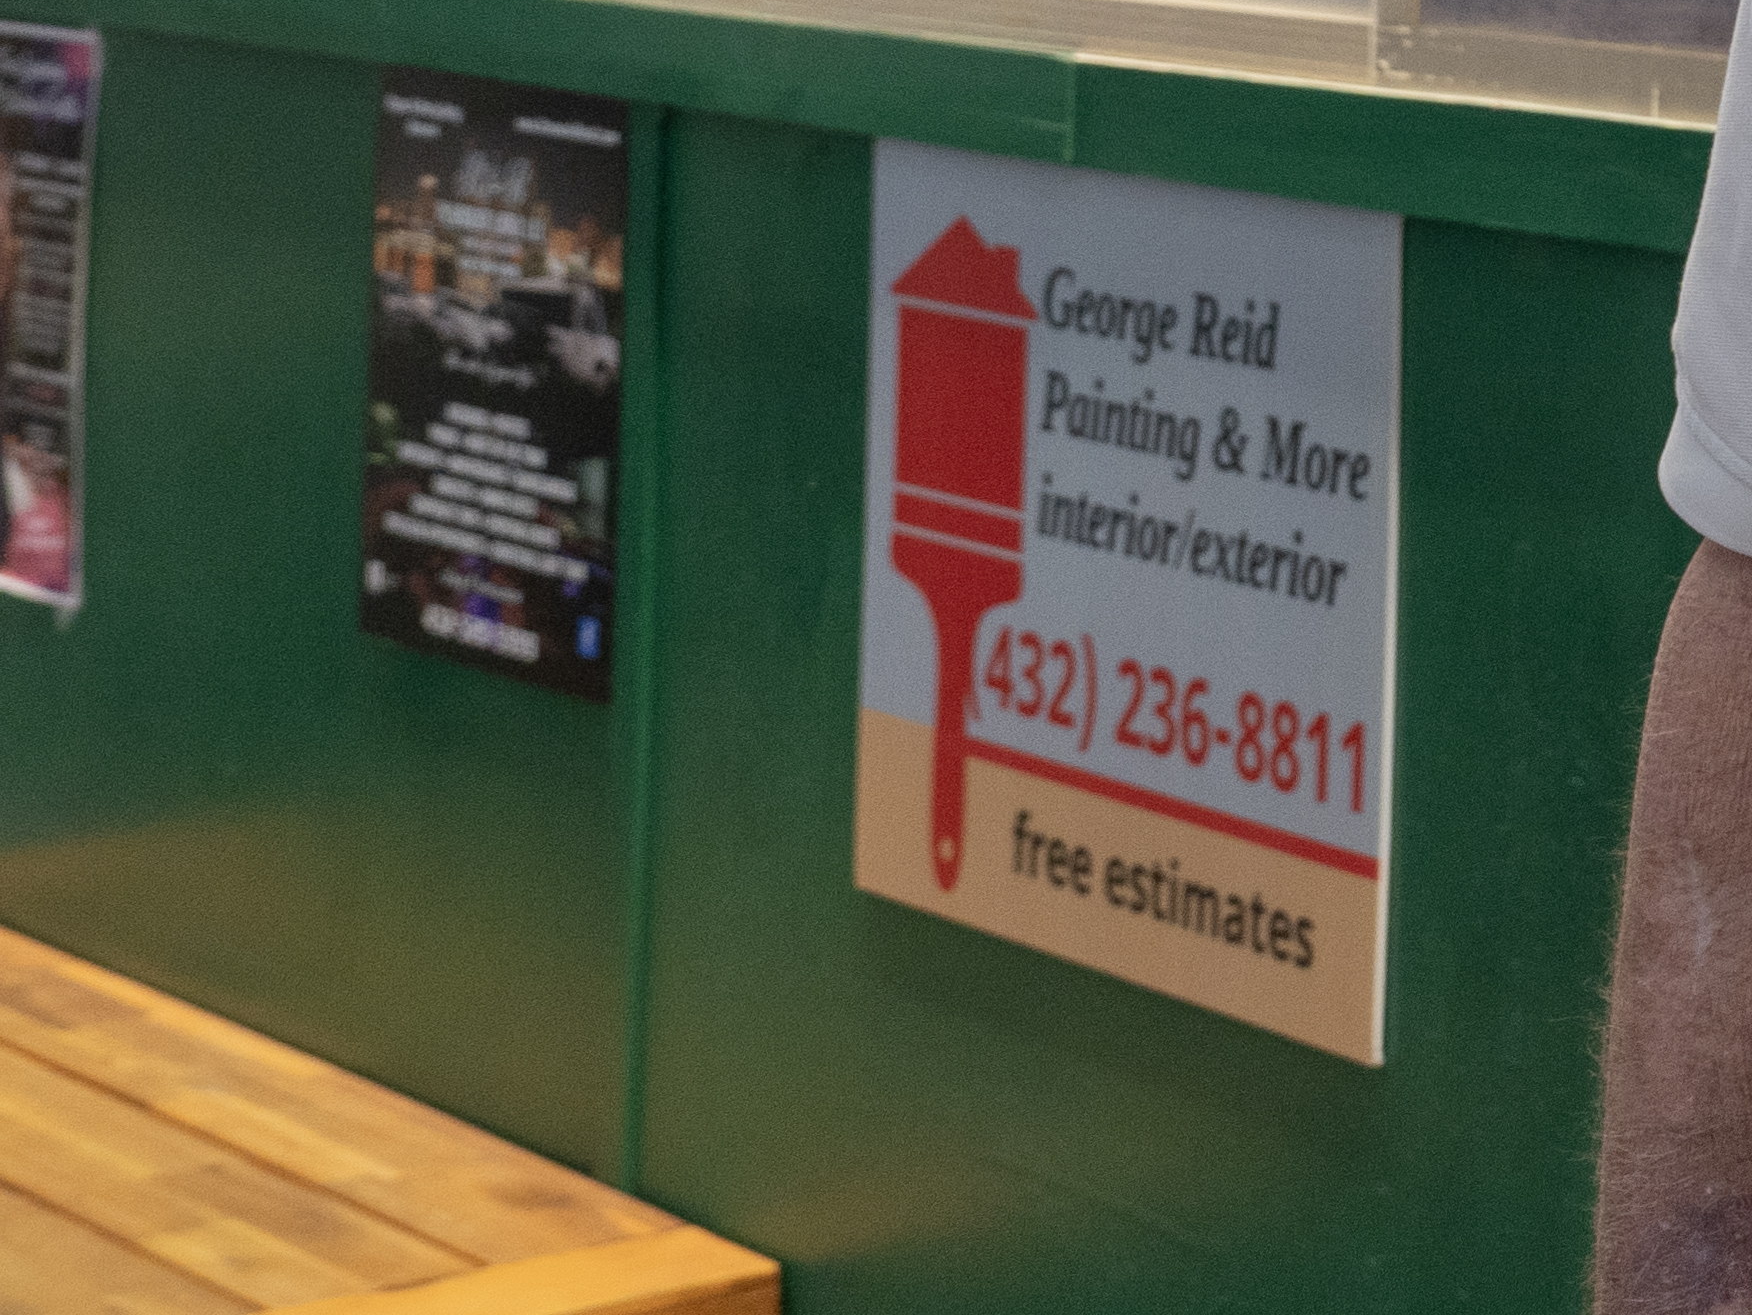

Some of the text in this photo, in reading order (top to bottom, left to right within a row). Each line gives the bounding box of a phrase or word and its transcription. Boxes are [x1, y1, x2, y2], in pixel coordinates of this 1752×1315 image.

[1043, 267, 1280, 371] George Reid
[1041, 370, 1370, 501] Painting & More
[1038, 472, 1347, 605] interior/exterior
[1114, 658, 1366, 813] 236-8811
[1012, 809, 1315, 968] free estimates
